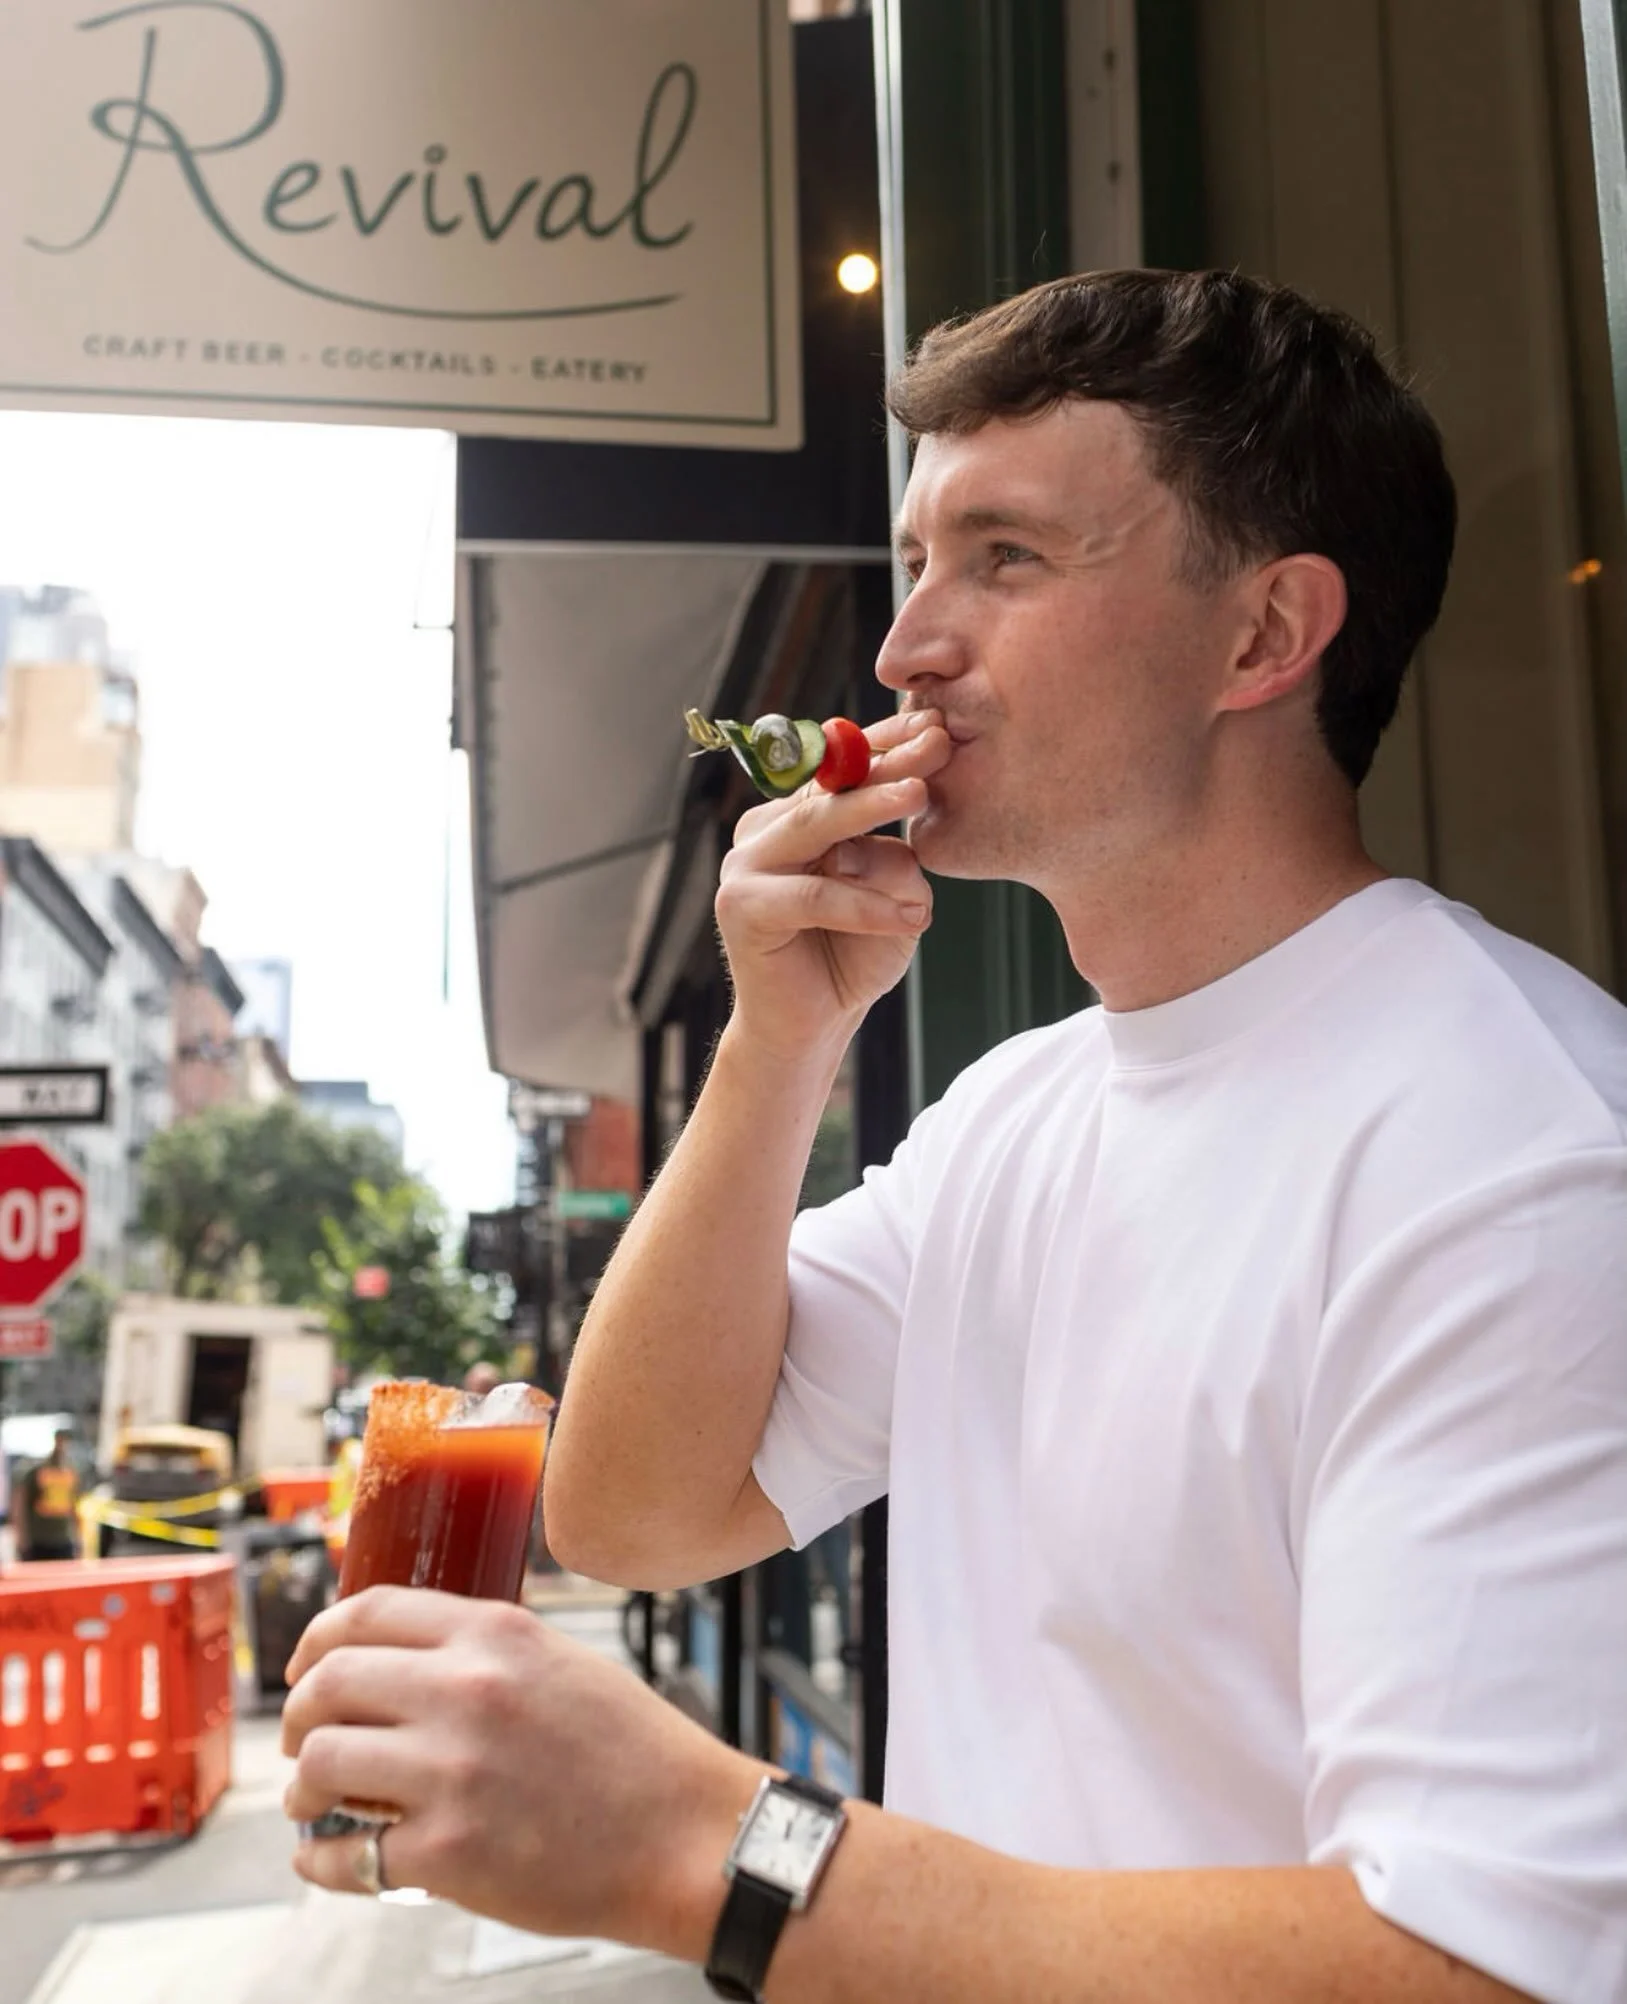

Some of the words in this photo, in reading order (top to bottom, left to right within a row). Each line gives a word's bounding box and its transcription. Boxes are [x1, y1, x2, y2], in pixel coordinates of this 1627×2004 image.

[25, 1, 697, 318] Revival
[83, 334, 188, 363] CRAFT
[202, 339, 286, 367] BEER
[321, 346, 496, 376] COCKTAILS
[531, 356, 647, 384] EATERY
[0, 1187, 81, 1262] OP
